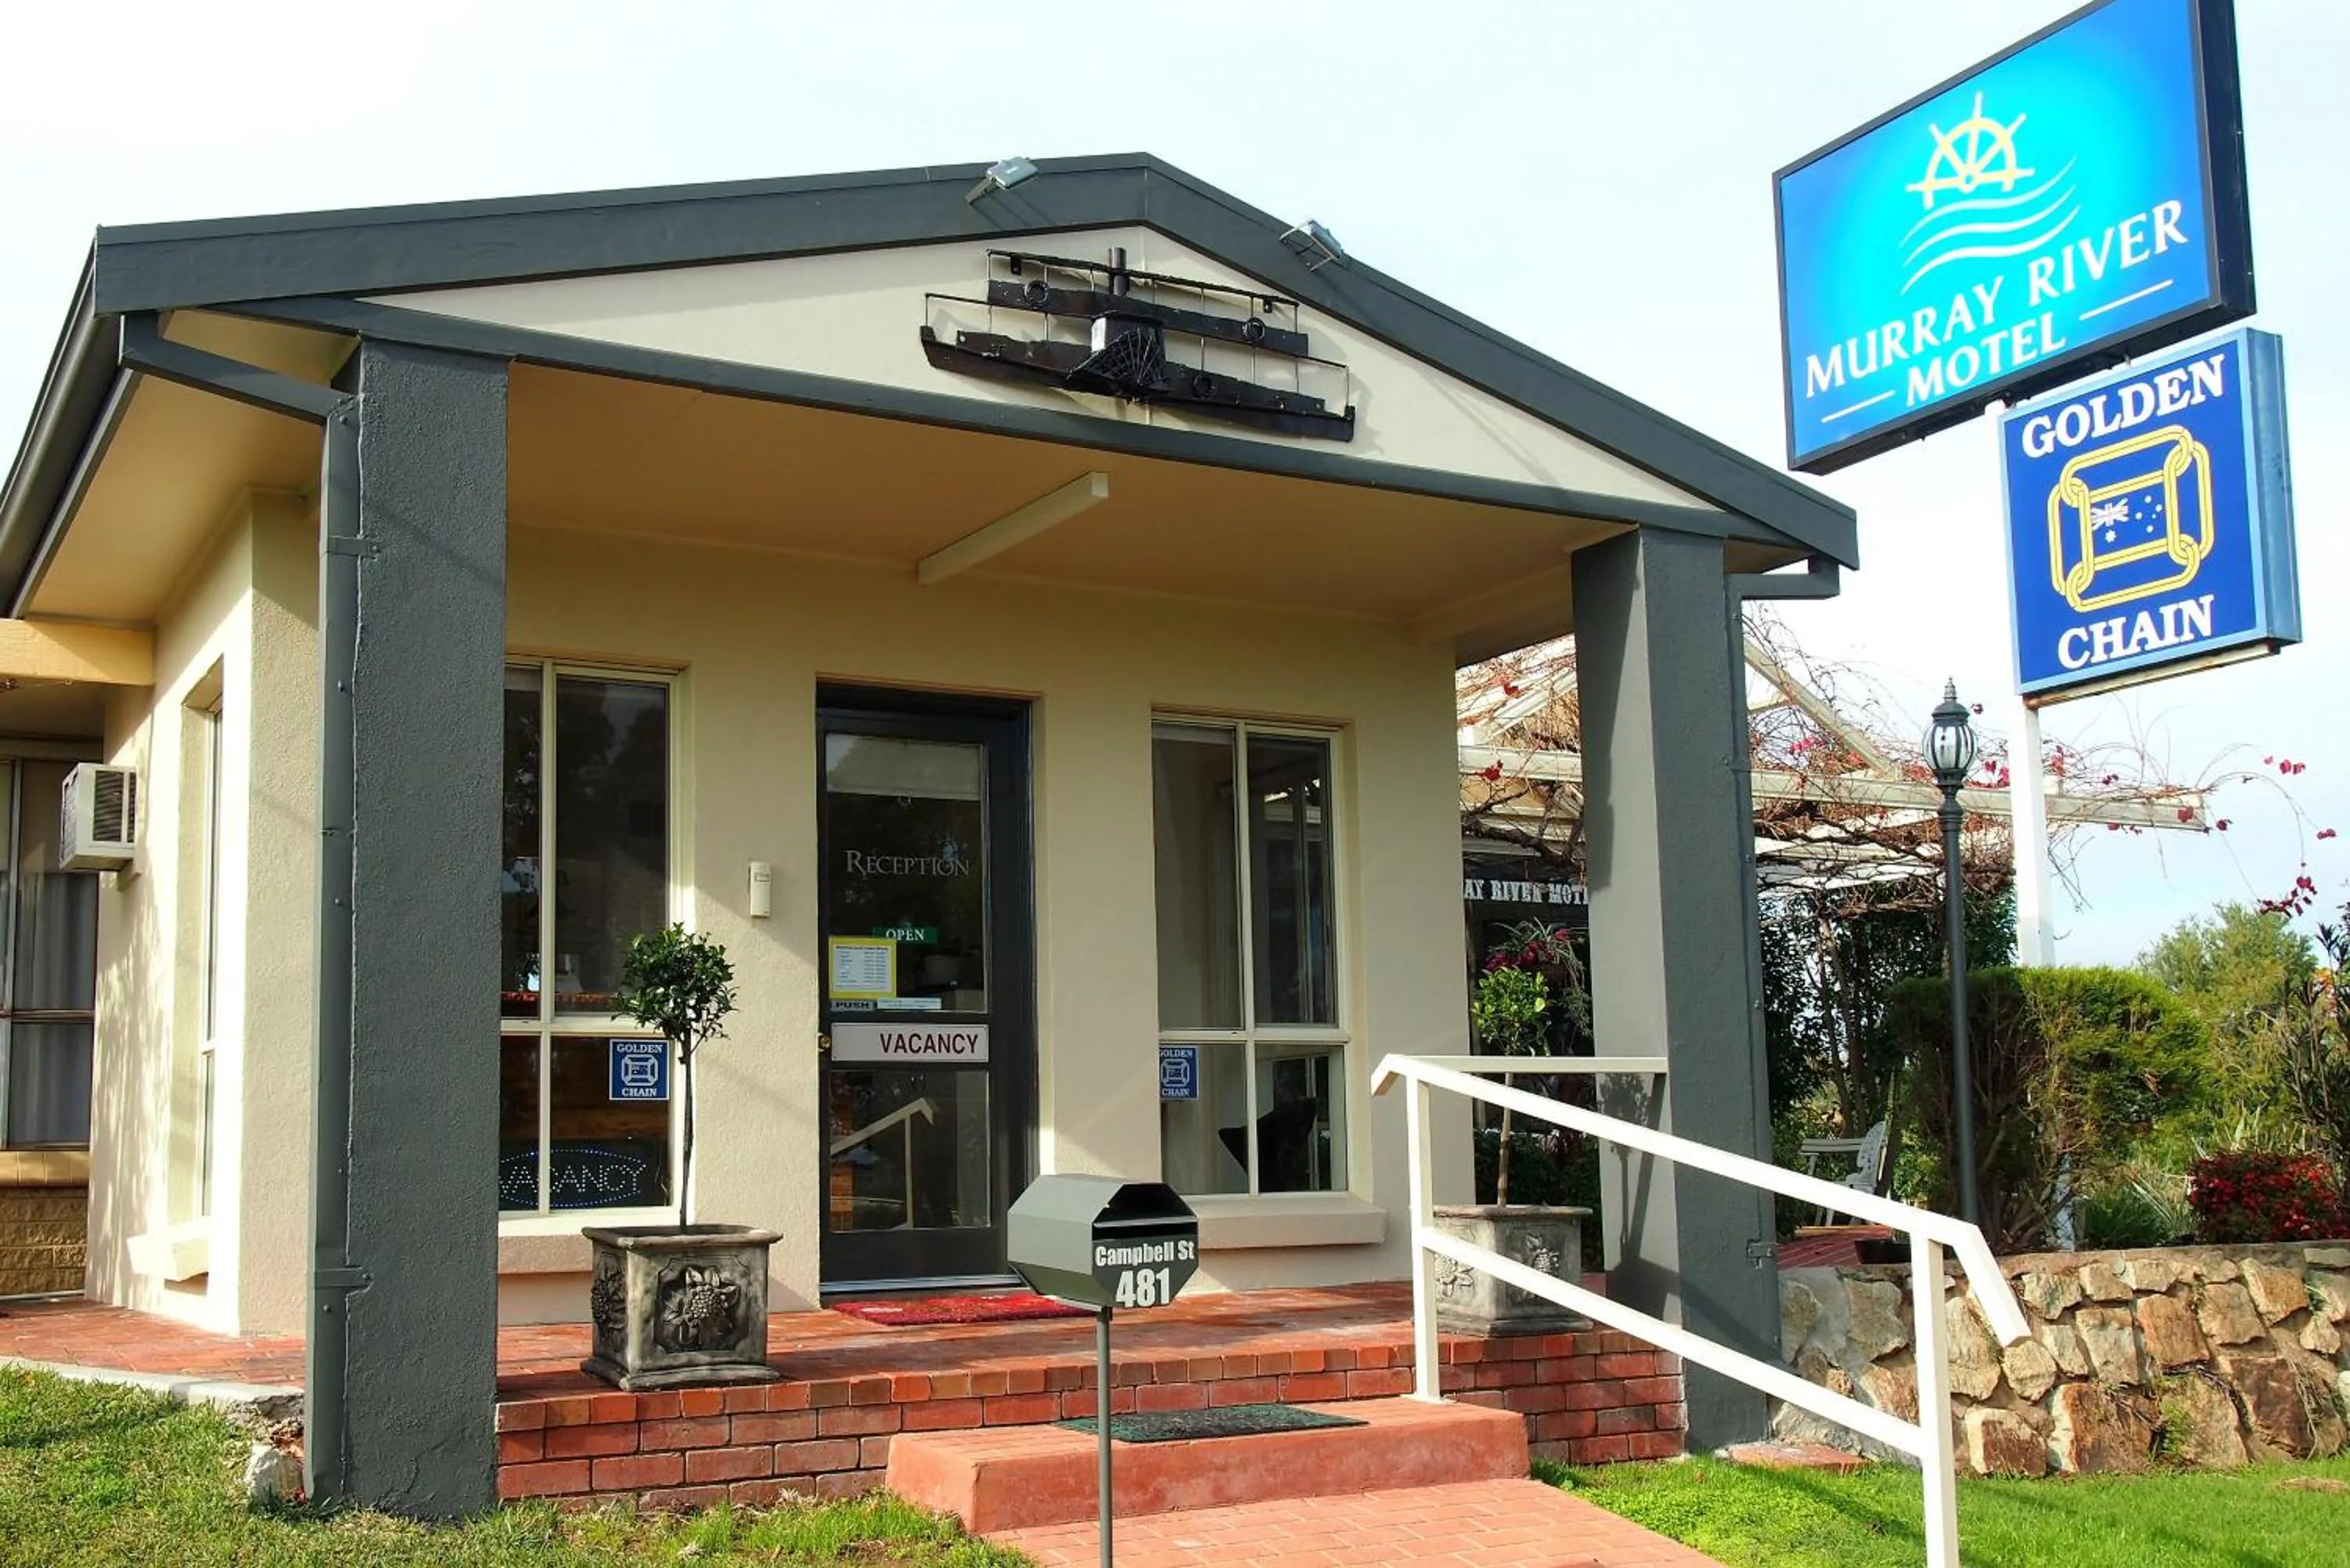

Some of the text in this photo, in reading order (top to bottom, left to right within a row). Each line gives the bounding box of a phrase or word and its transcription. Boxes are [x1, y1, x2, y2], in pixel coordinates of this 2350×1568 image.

[1805, 200, 2189, 398] MURRAY RIVER
[1904, 317, 2066, 407] MOTEL
[2022, 354, 2228, 459] GOLDEN
[2057, 594, 2214, 670] CHAIN
[886, 928, 925, 941] OPEN
[616, 1043, 663, 1053] GOLDEN
[880, 1033, 978, 1054] VACANCY
[621, 1087, 657, 1097] CHAIN
[1095, 1240, 1195, 1267] Campbell St
[1115, 1267, 1170, 1308] 481
